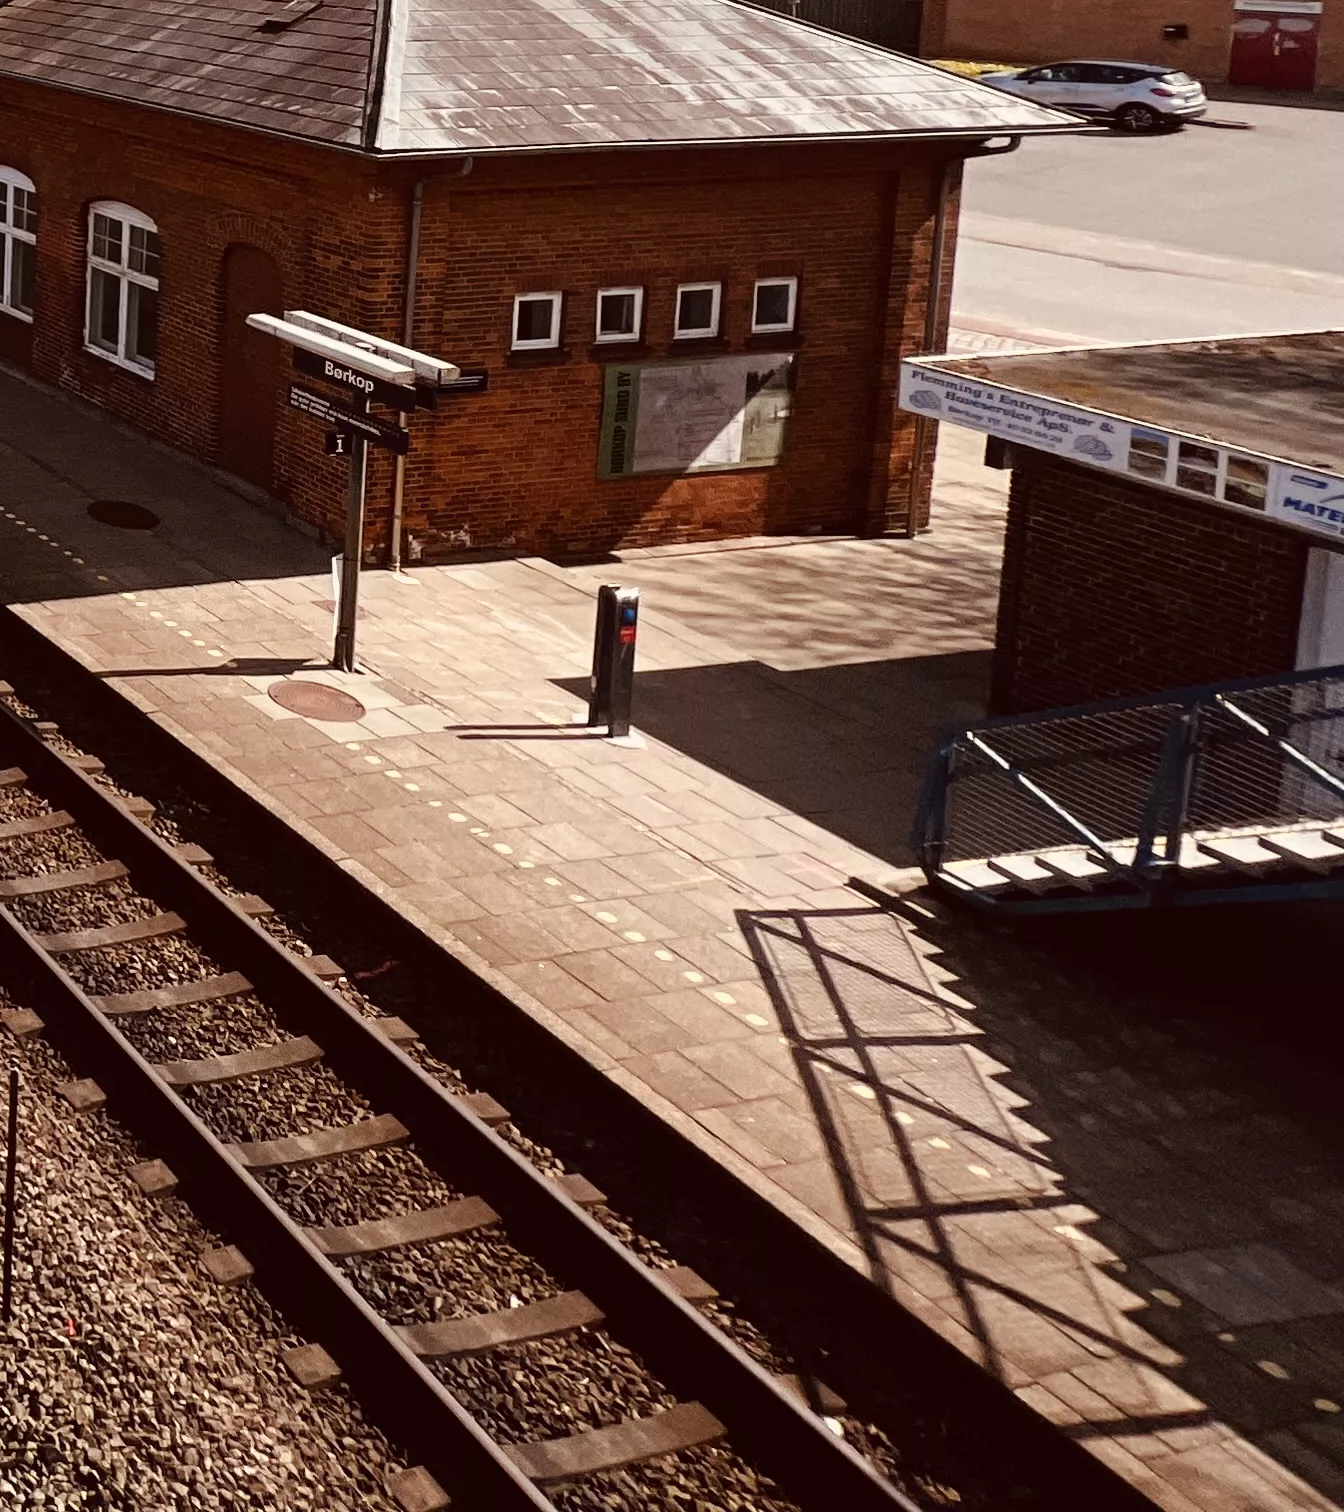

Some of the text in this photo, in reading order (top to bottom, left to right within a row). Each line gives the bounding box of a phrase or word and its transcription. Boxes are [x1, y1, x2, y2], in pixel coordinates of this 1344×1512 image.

[324, 360, 375, 394] Børkop
[617, 371, 631, 387] BY
[945, 391, 1032, 422] Haveservice
[1099, 421, 1115, 434] &
[335, 439, 344, 453] 1
[1283, 496, 1344, 524] MATE
